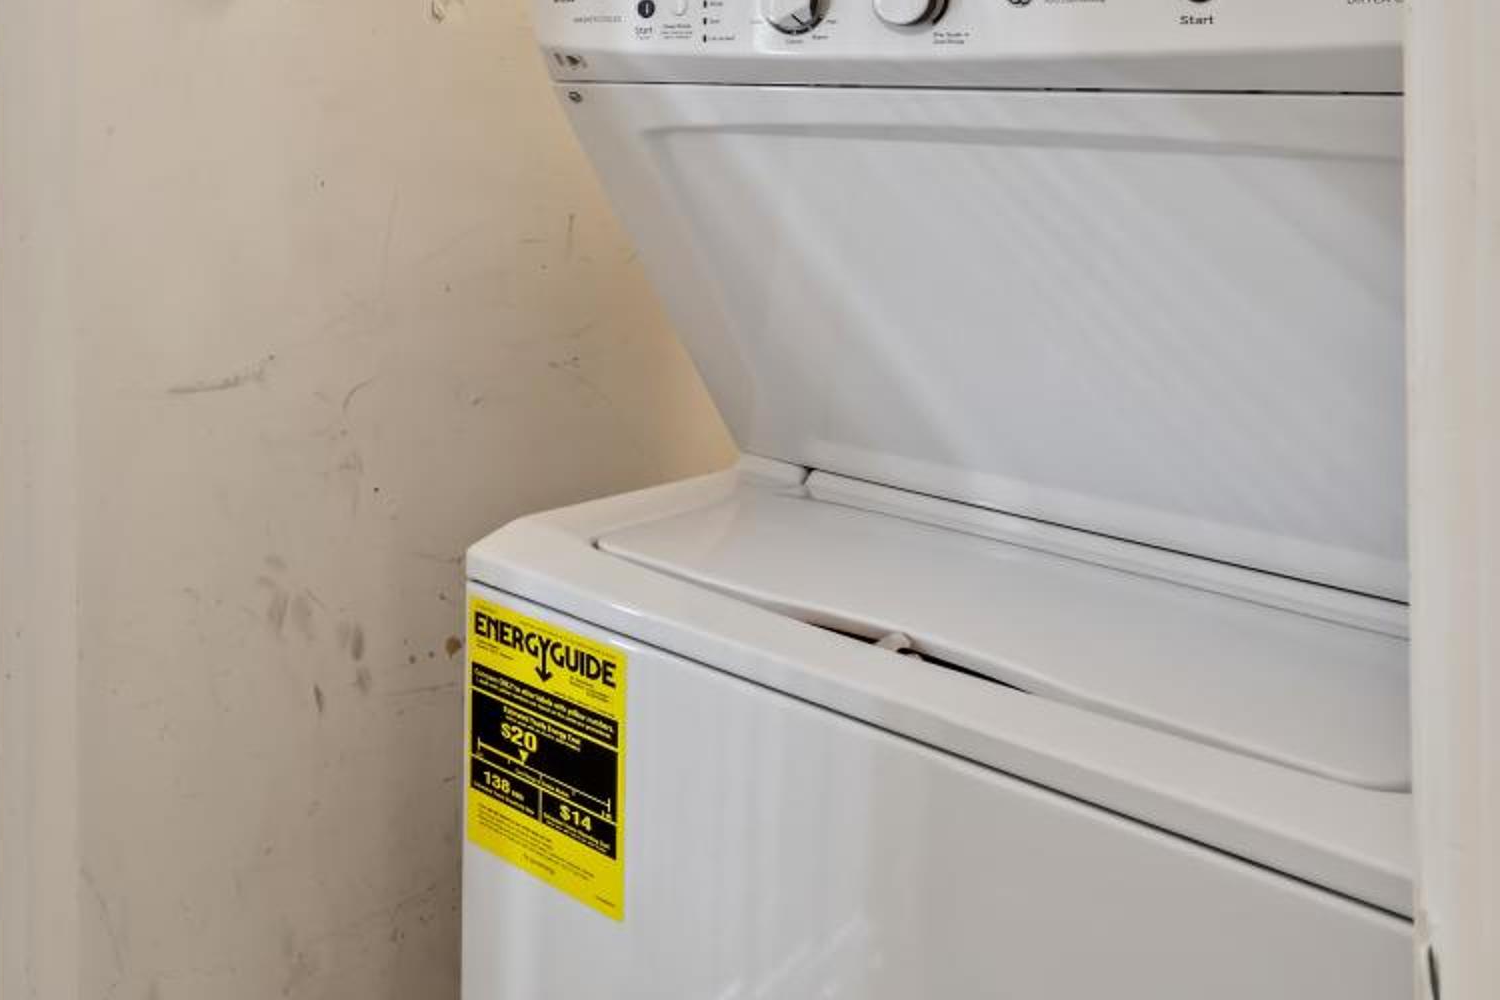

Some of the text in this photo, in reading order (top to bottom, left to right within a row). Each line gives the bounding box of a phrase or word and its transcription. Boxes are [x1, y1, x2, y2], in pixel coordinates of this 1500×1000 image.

[1178, 15, 1214, 25] Start
[474, 611, 616, 688] ENERGYGUIDE
[501, 723, 537, 752] $20
[484, 771, 510, 793] 138
[559, 805, 592, 831] $14
